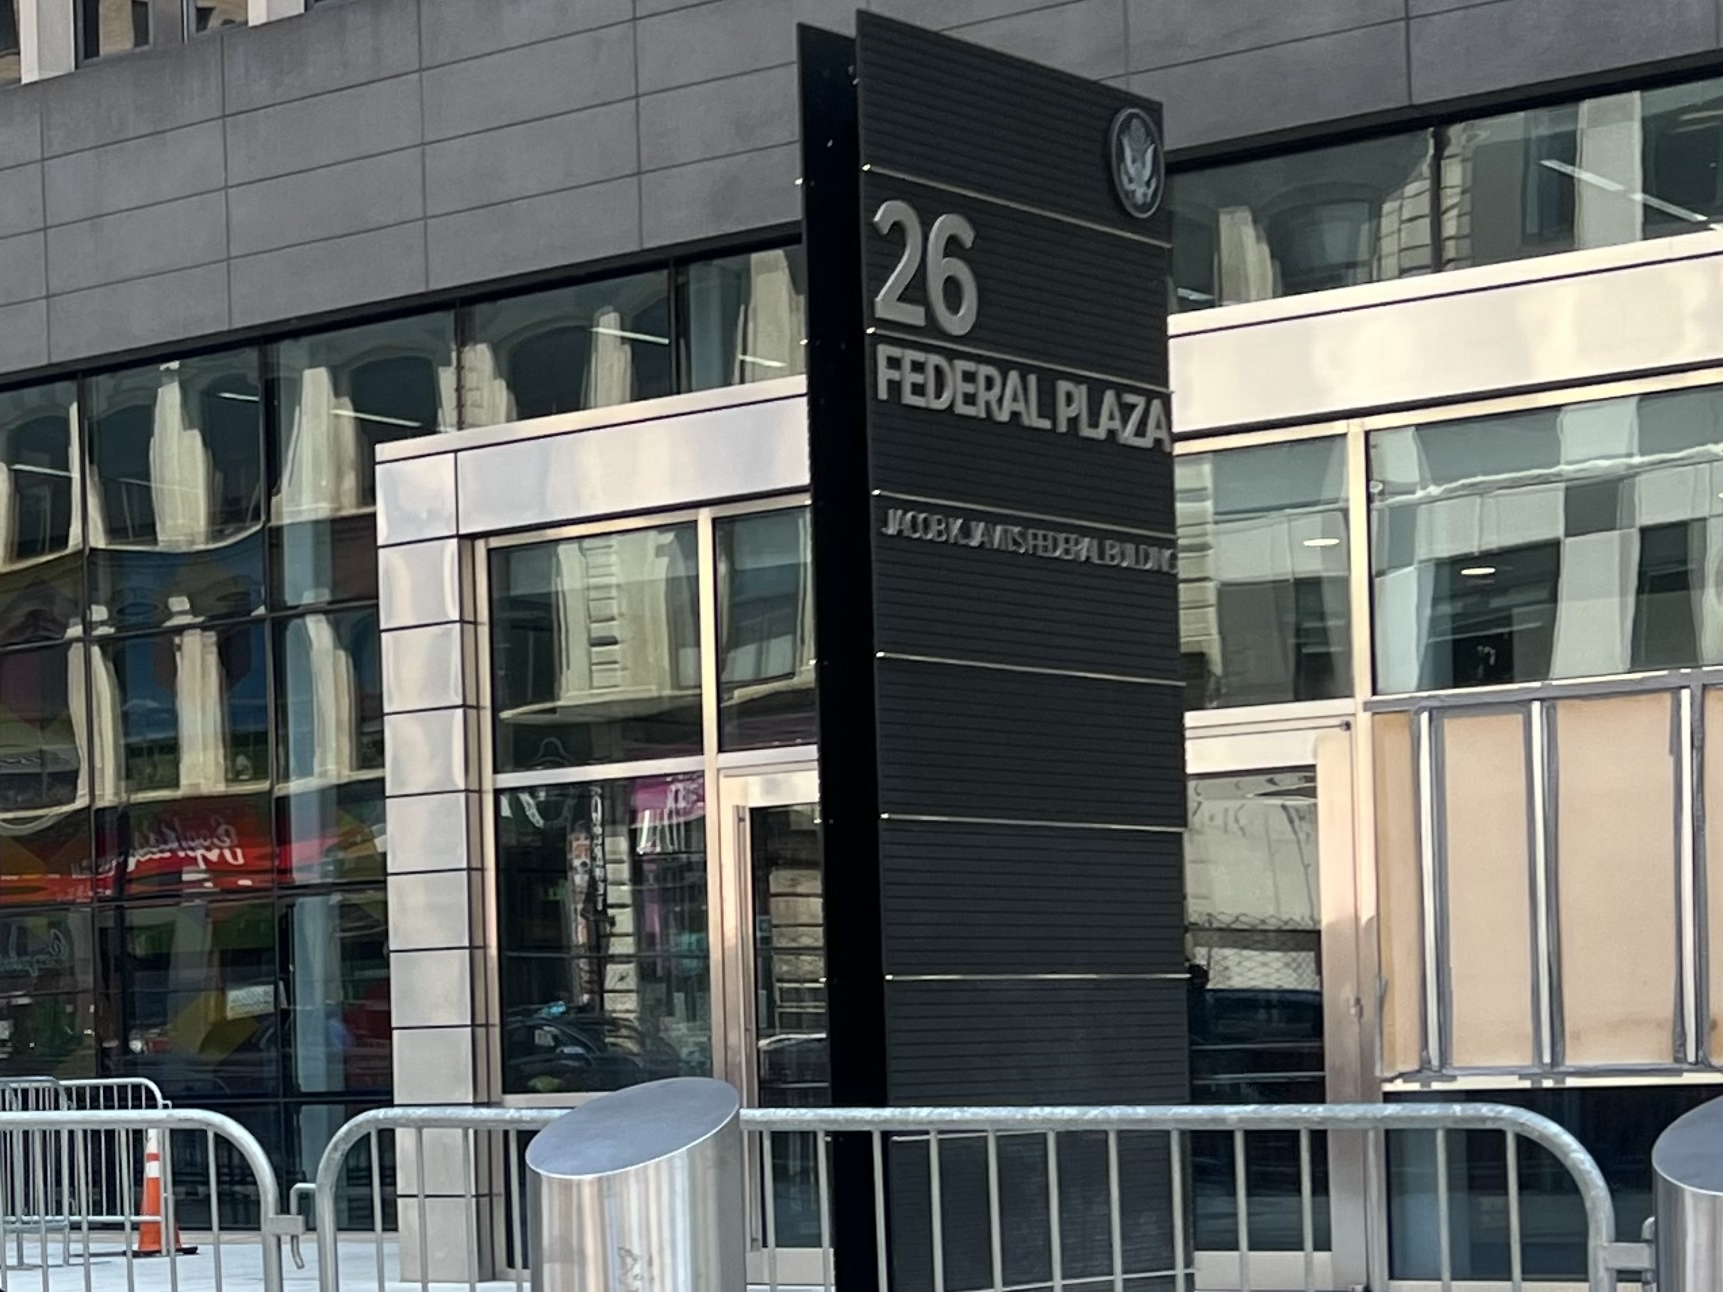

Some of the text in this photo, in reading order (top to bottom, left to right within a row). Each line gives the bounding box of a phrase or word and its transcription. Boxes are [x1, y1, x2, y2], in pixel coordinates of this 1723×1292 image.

[873, 199, 977, 336] 26
[876, 343, 1174, 452] FEDERAL PLAZA
[881, 508, 948, 541] JACOB
[1027, 528, 1105, 564] FEDERAL
[1105, 540, 1178, 574] BUILDING
